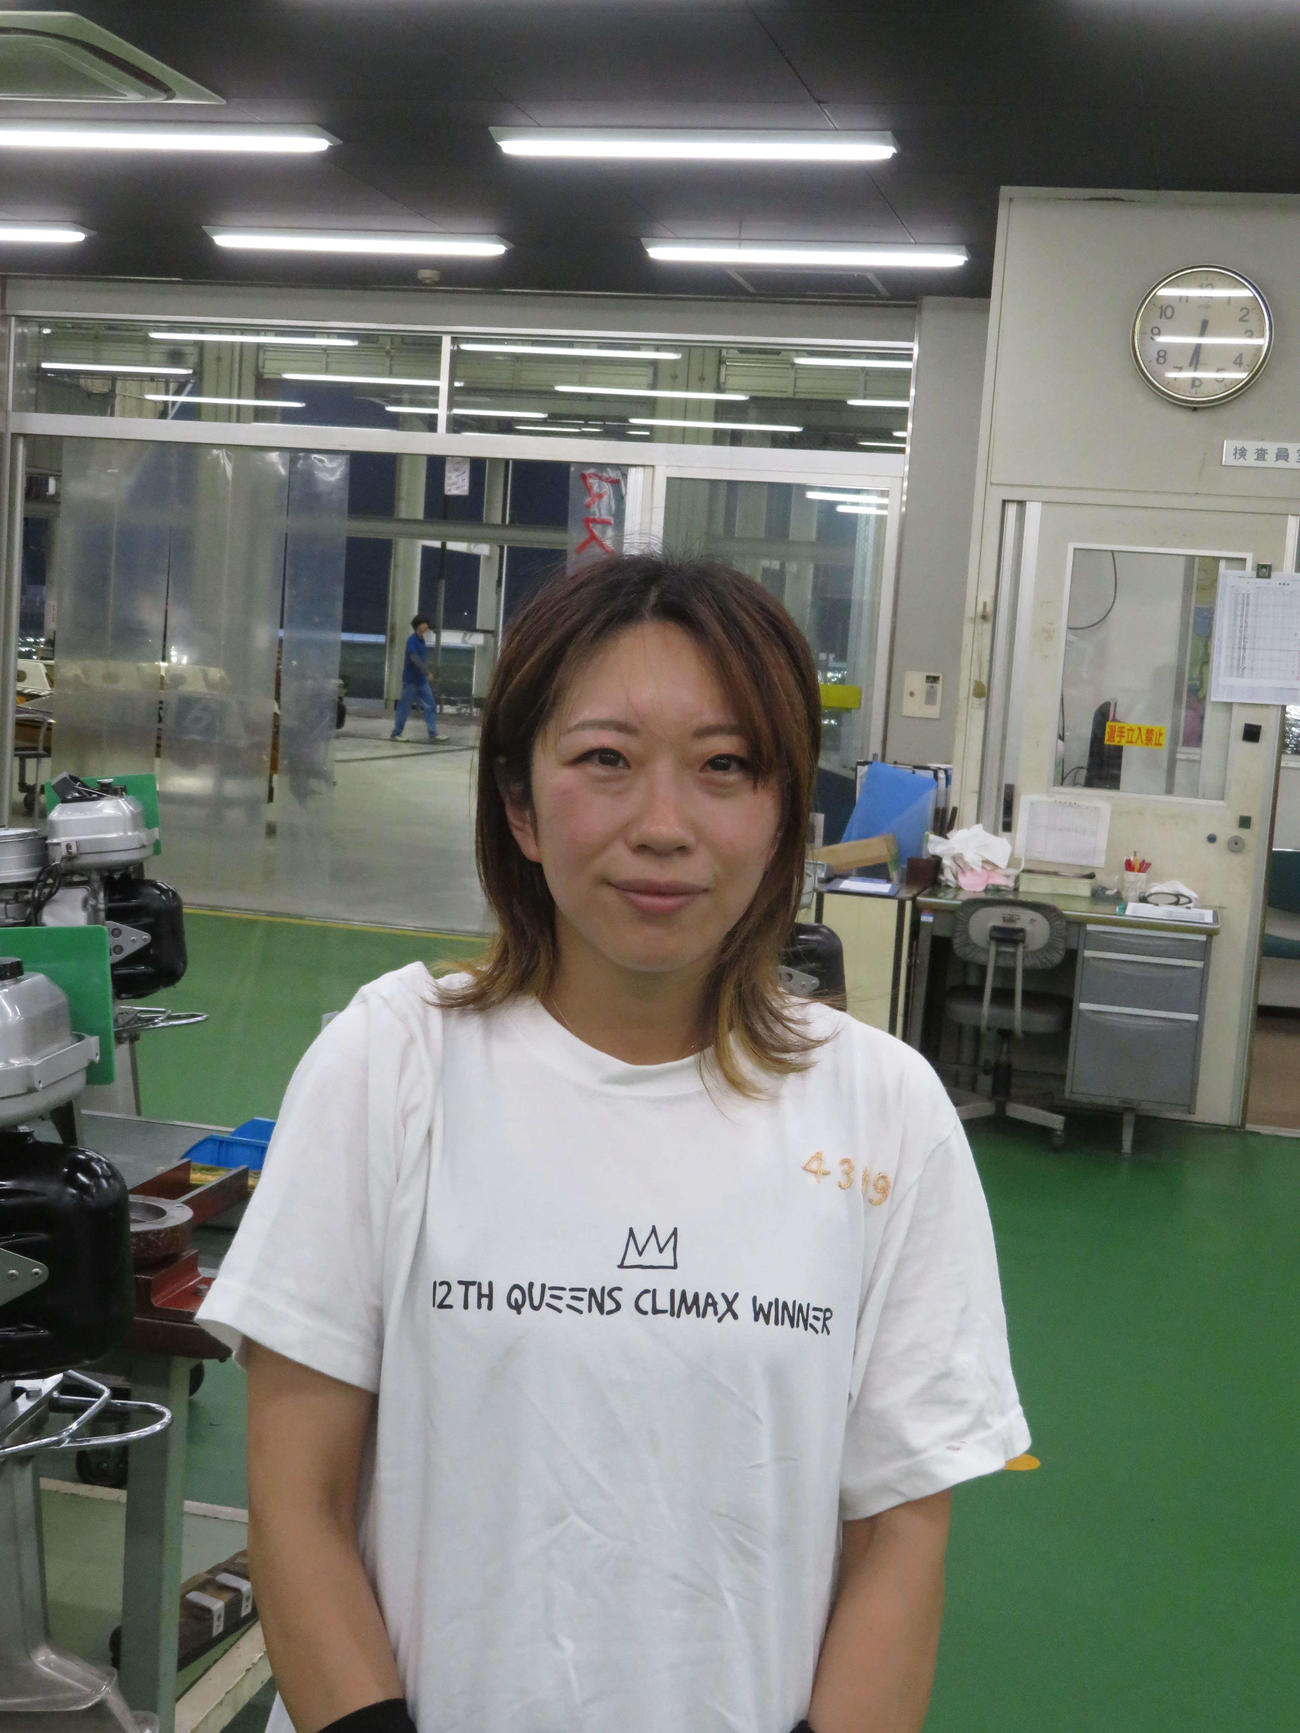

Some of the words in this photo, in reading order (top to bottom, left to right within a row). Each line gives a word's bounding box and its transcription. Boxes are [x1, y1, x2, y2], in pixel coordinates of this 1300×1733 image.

[1160, 304, 1175, 320] 10
[1239, 307, 1250, 322] 2
[1150, 326, 1161, 341] 9
[1156, 349, 1167, 365] 8
[1233, 352, 1244, 368] 4
[1233, 446, 1300, 463] 検査員
[801, 1151, 891, 1206] 4319
[433, 1280, 493, 1311] 12TH
[506, 1281, 623, 1315] QUEENS
[634, 1288, 740, 1323] CLIMAX
[752, 1295, 833, 1336] WINNER
